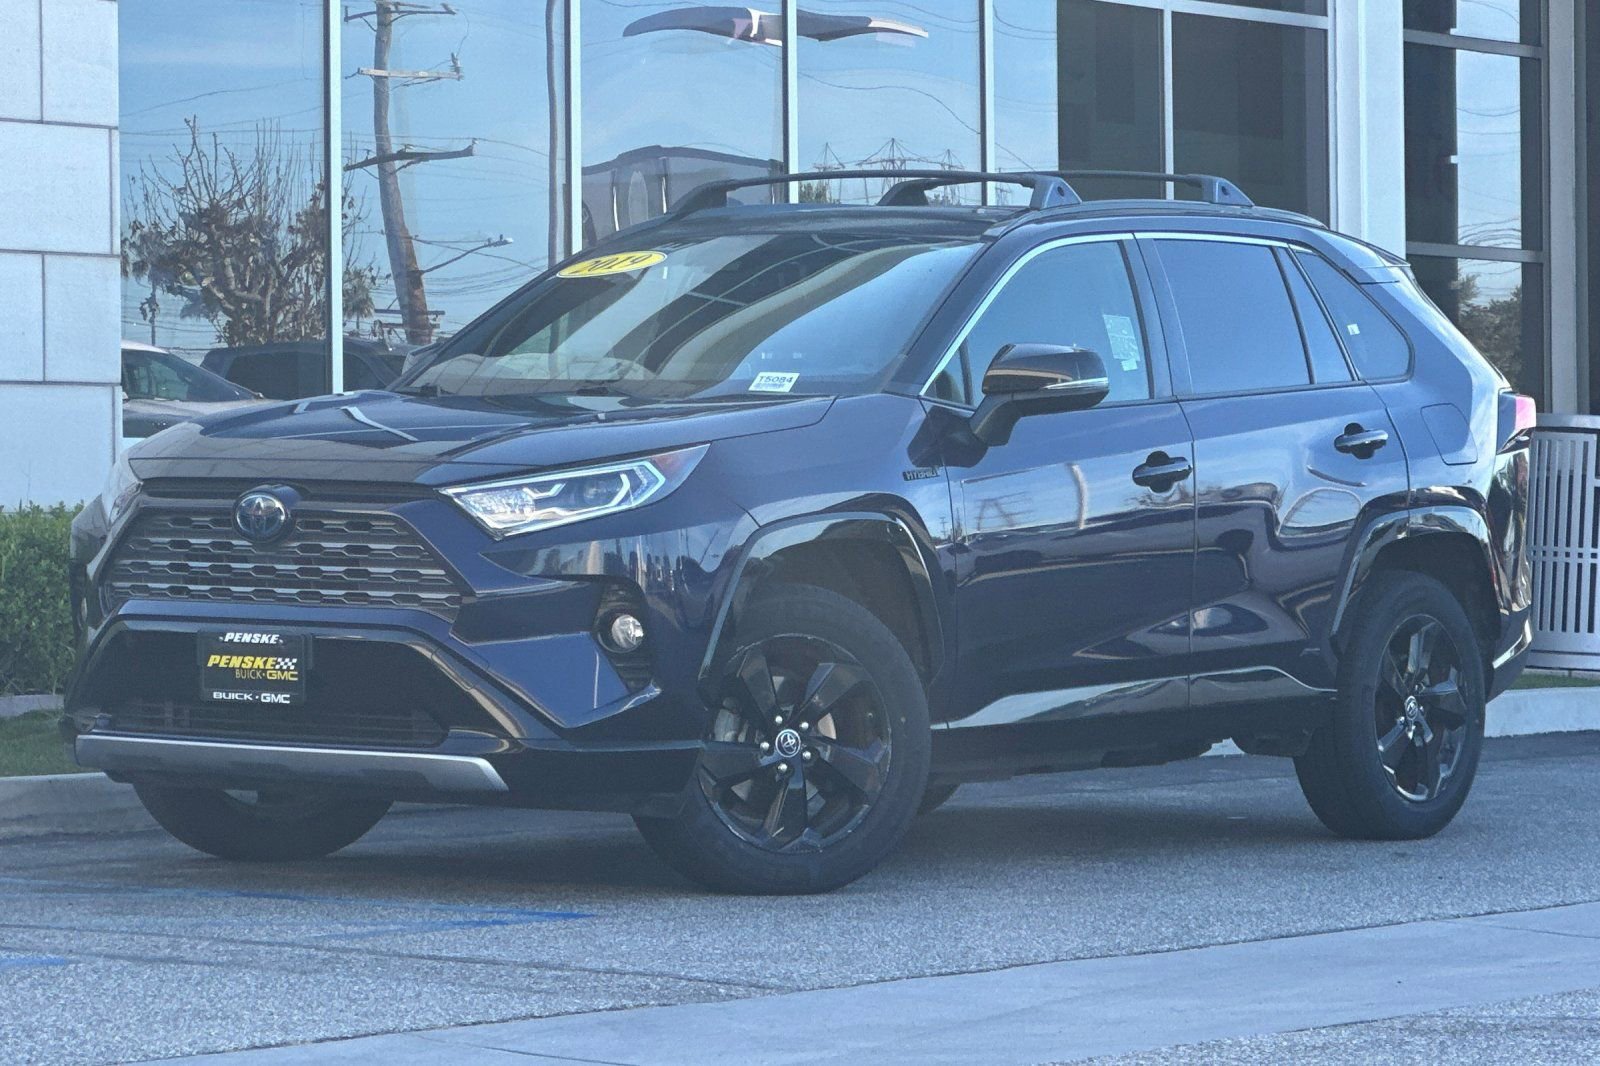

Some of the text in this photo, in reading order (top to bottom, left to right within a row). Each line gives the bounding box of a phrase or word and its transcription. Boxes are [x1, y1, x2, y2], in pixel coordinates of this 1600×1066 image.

[224, 632, 280, 644] PENSKE
[207, 655, 277, 669] PENSKE
[266, 670, 298, 681] GMC
[213, 692, 291, 704] BUICK GMC
